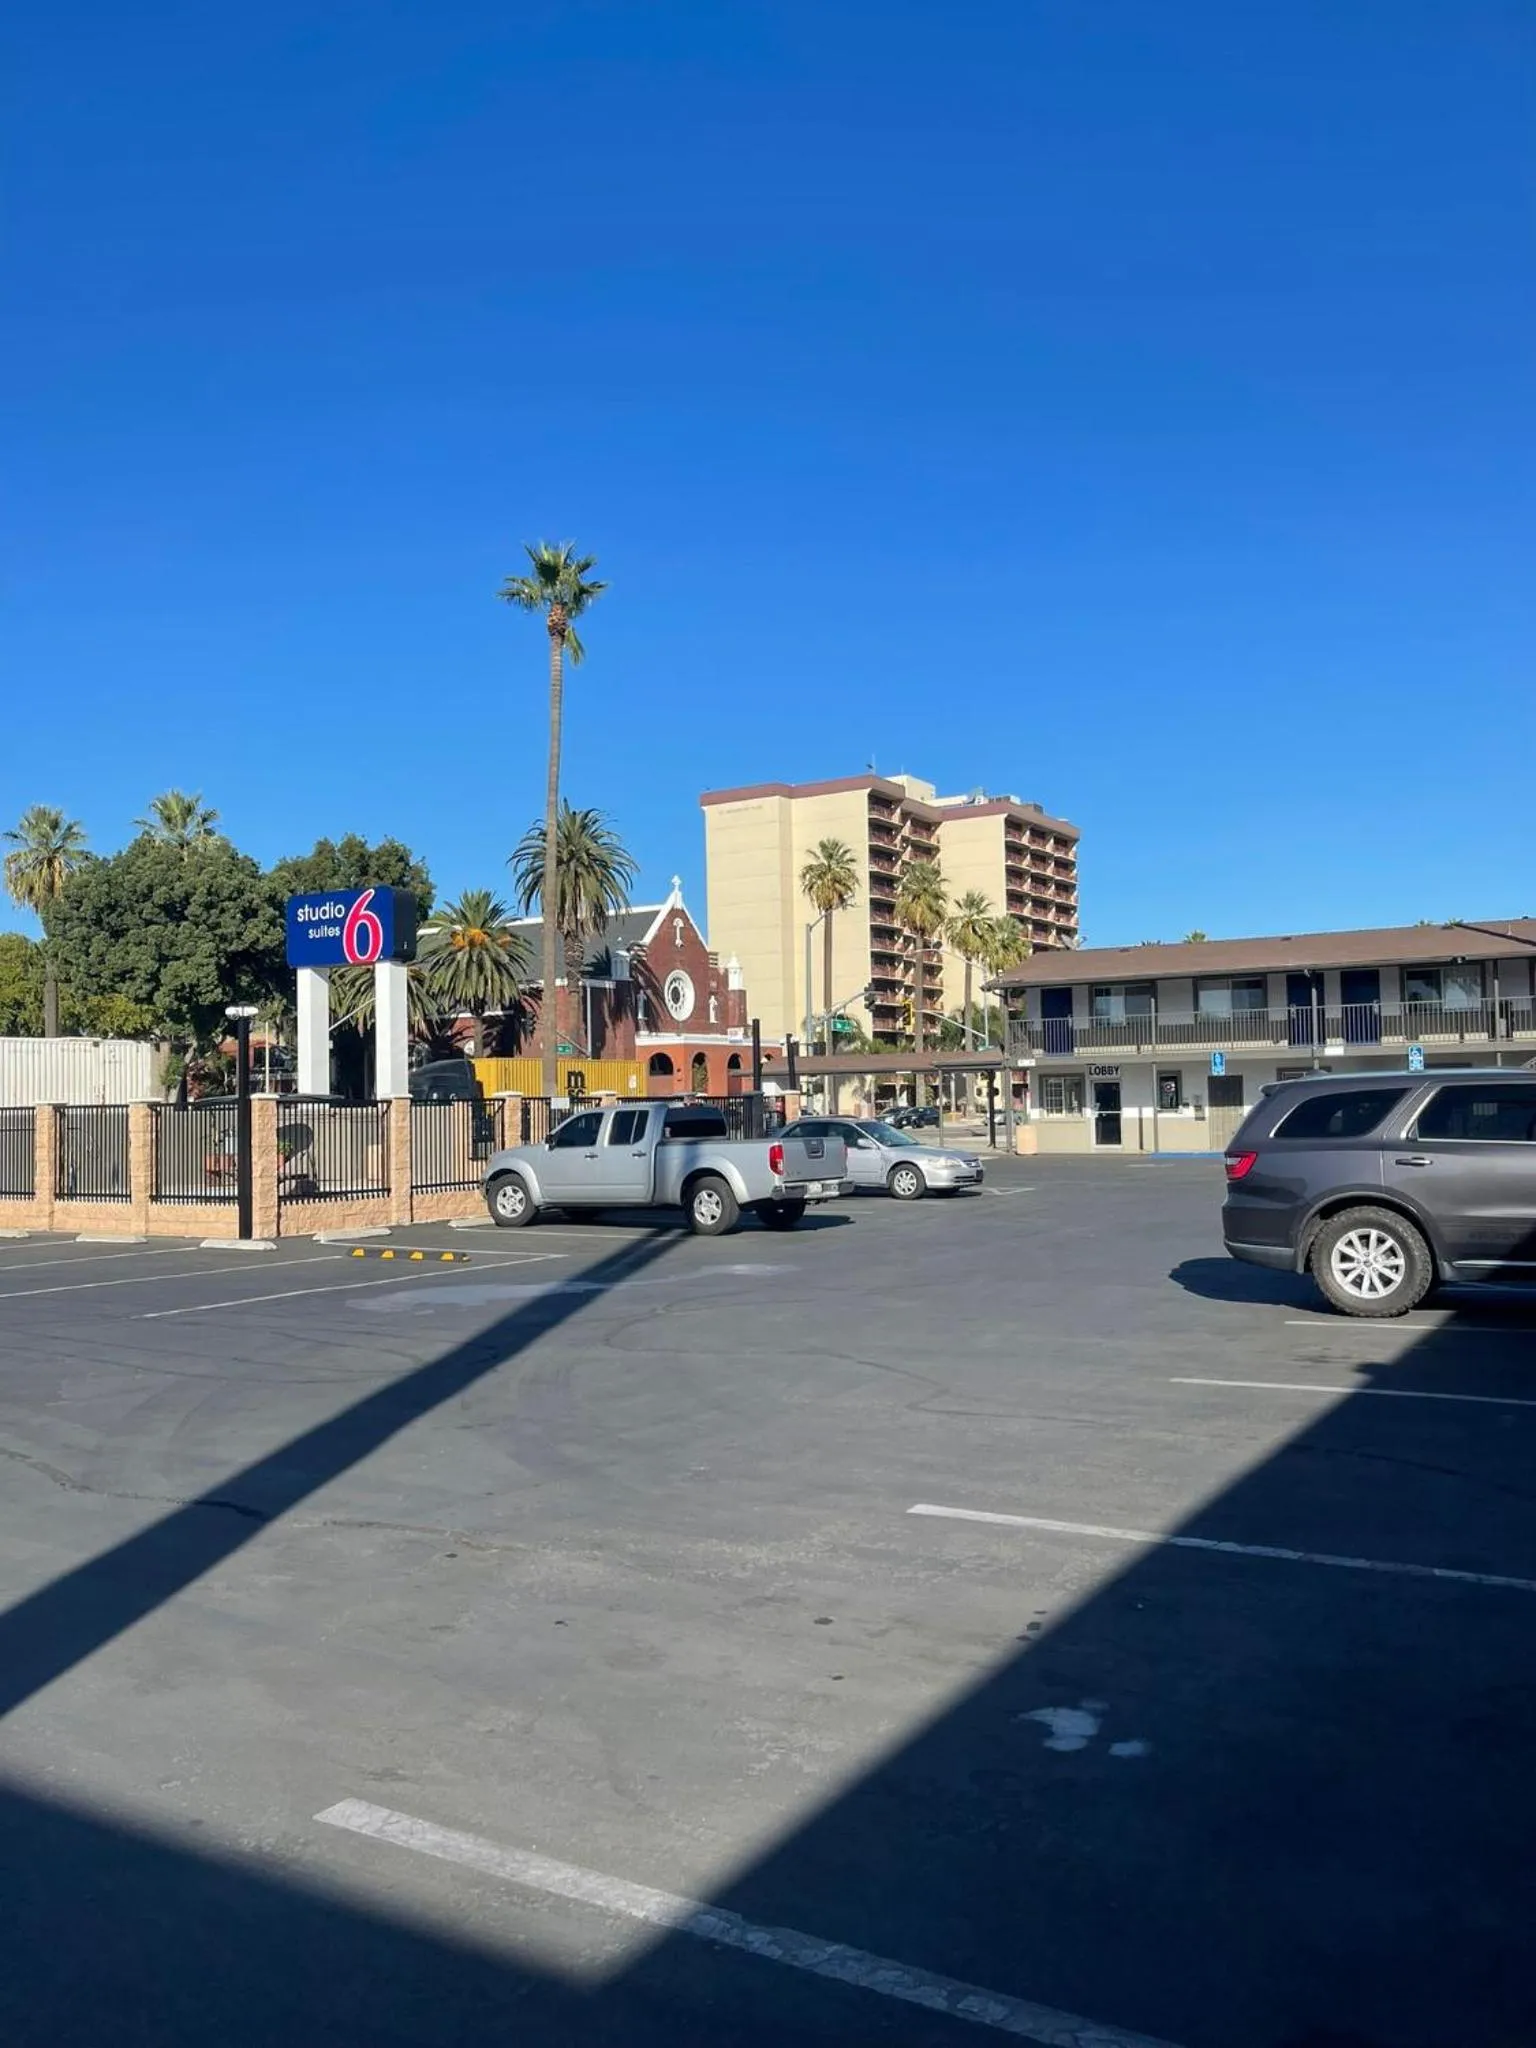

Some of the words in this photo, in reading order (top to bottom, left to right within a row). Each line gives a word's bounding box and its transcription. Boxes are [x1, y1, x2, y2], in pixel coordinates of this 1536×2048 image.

[297, 902, 345, 922] studio
[308, 925, 341, 939] suites
[343, 888, 383, 965] 6
[1088, 1065, 1120, 1076] LOBBY
